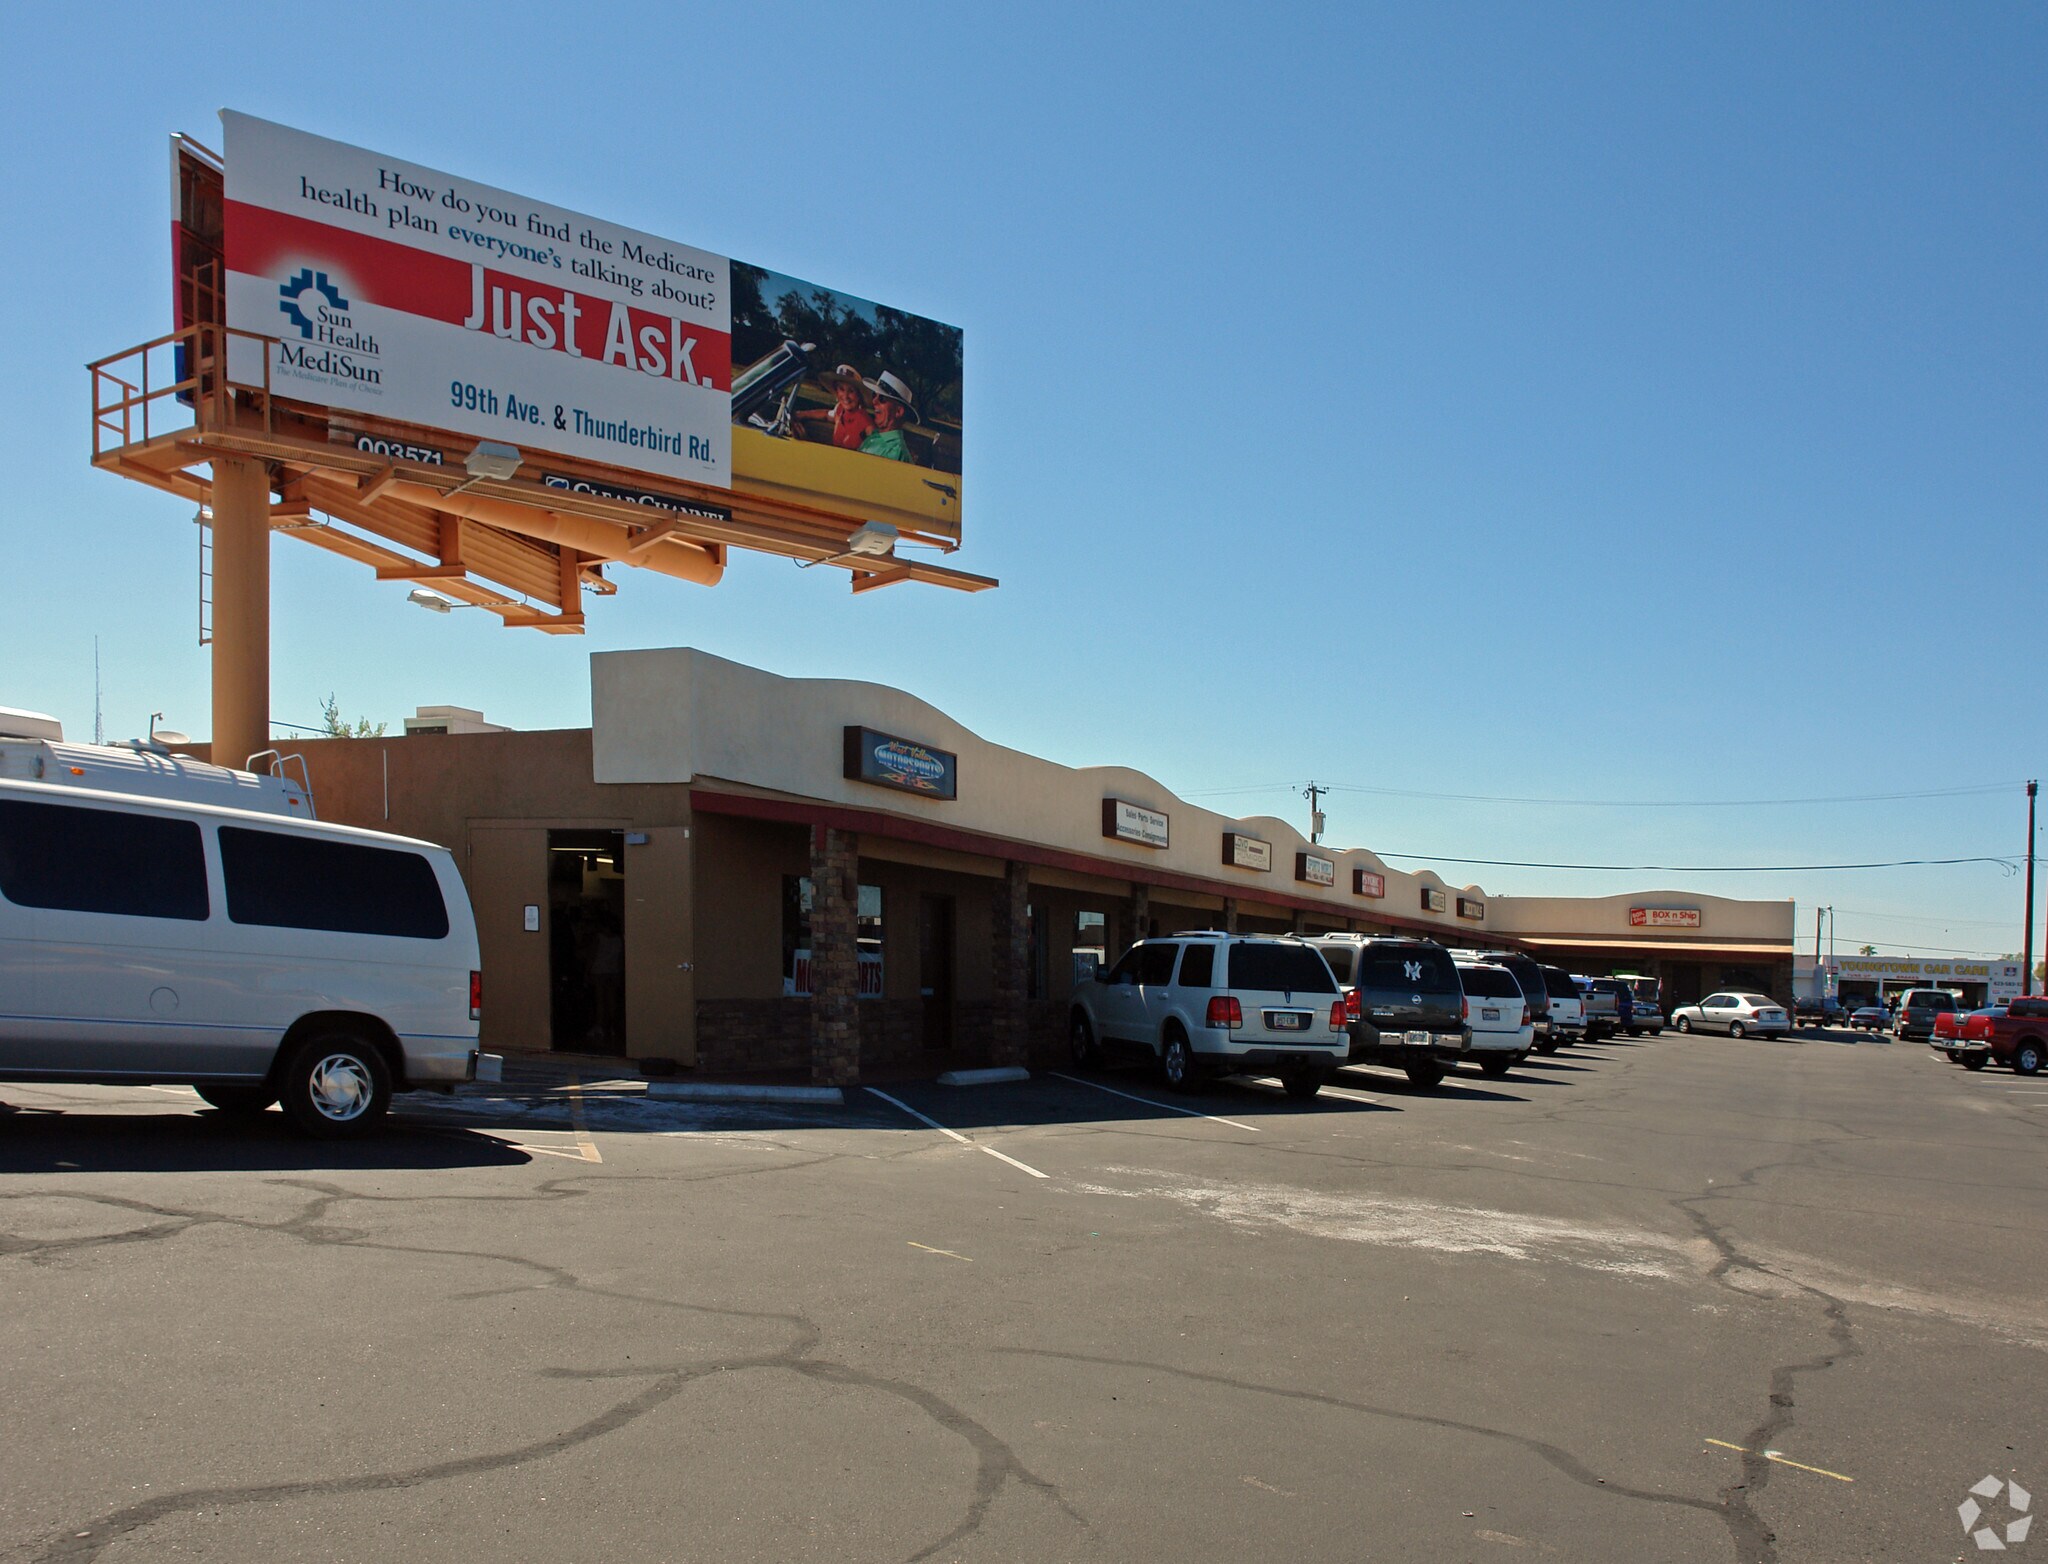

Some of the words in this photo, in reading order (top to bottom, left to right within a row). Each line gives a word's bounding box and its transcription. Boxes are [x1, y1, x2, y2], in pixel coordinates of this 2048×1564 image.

[378, 168, 435, 203] How
[441, 188, 470, 213] do
[476, 205, 518, 229] you
[527, 213, 570, 243] find
[580, 227, 613, 254] the
[622, 240, 715, 284] Medicare
[300, 176, 377, 217] health
[388, 204, 438, 235] plan
[448, 224, 562, 268] everyone's
[571, 258, 643, 296] talking
[651, 278, 716, 312] about?
[317, 304, 352, 329] Sun
[463, 262, 582, 358] Just
[602, 301, 714, 389] Ask.
[319, 324, 380, 355] Health
[280, 341, 382, 385] MediSun
[276, 366, 290, 376] The
[292, 369, 329, 384] Medicare
[331, 376, 348, 389] Plan
[359, 383, 384, 396] Choice
[450, 380, 498, 416] 99th
[505, 394, 546, 426] Ave.
[553, 404, 567, 432] &
[572, 408, 682, 456] Thunderbird
[688, 435, 716, 464] Rd.
[357, 436, 443, 466] 003571
[1125, 808, 1137, 820] Sales
[1138, 812, 1149, 823] Parts
[1150, 816, 1164, 828] Service
[1652, 910, 1671, 919] BOX
[1679, 910, 1697, 921] Ship
[1839, 960, 1920, 974] YOUNGTOWN
[1924, 963, 1951, 975] CAR
[1954, 964, 1989, 977] CARE
